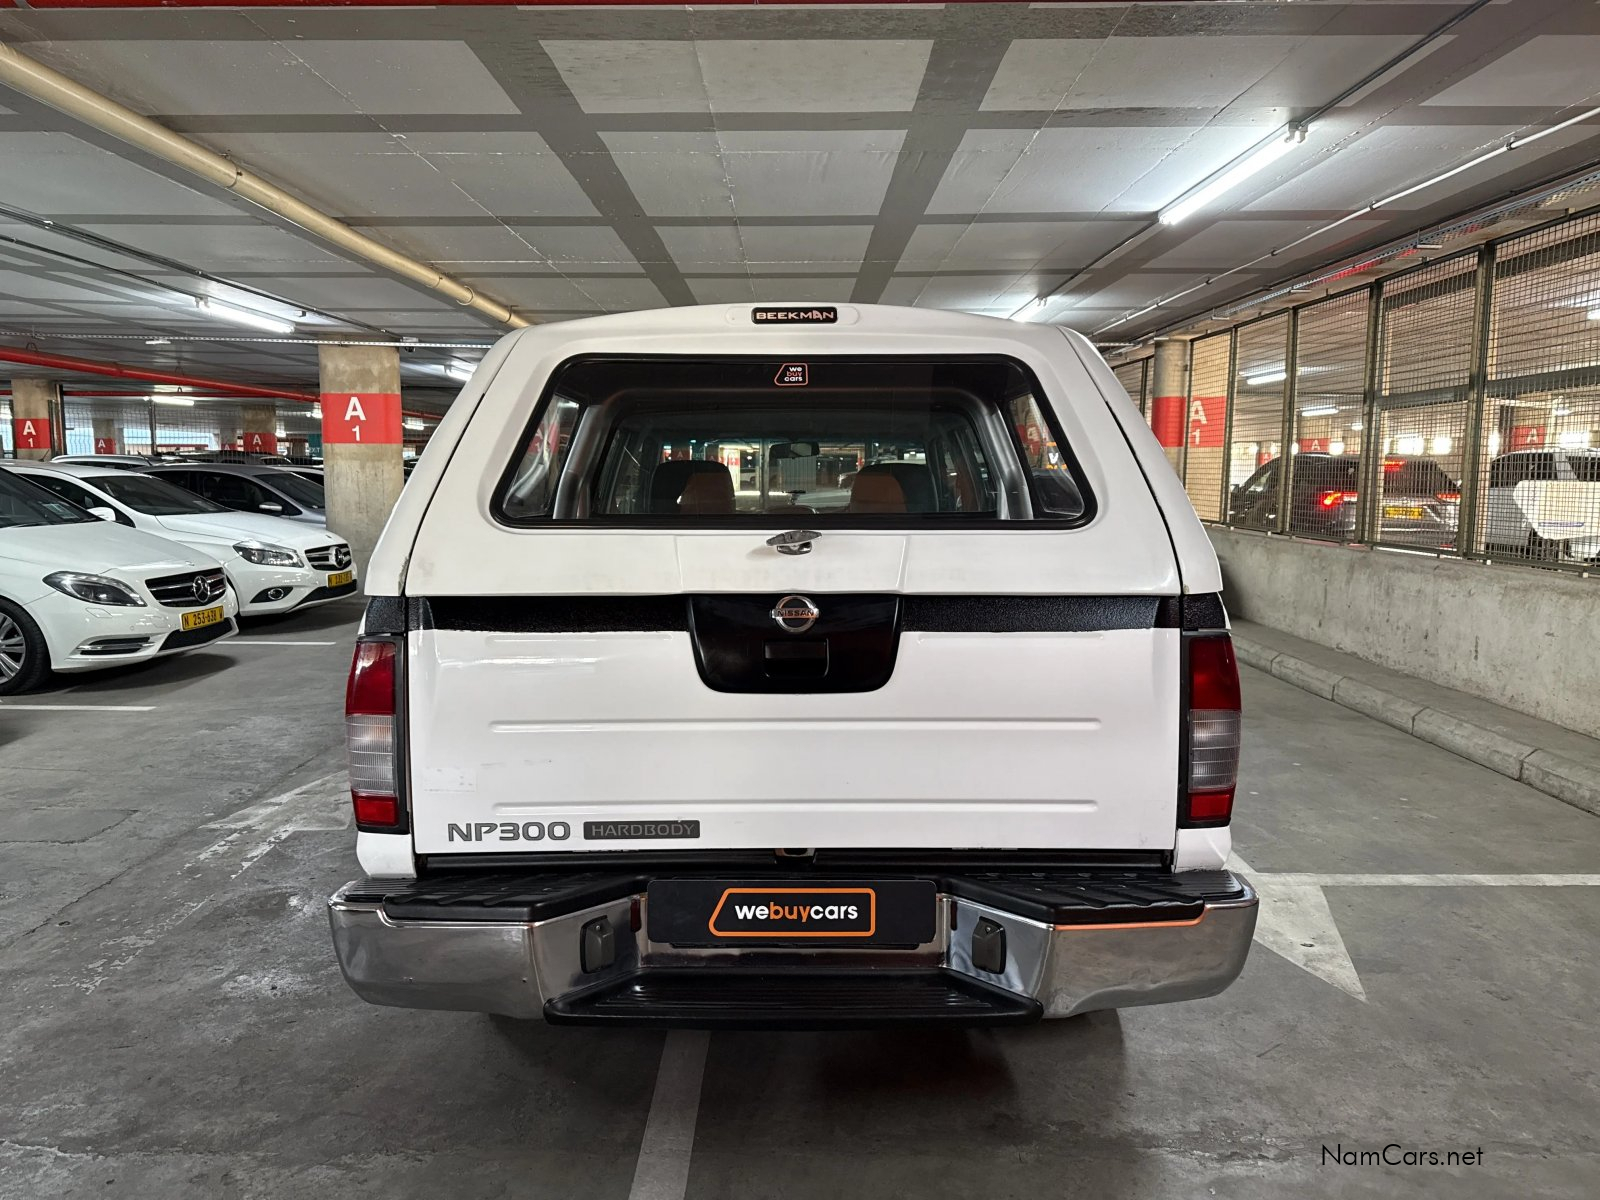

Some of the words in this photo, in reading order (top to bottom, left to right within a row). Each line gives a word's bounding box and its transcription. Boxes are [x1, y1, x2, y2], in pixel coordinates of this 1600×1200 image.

[756, 309, 834, 321] BEEKMAN
[344, 396, 367, 421] A
[1189, 400, 1207, 425] A
[23, 420, 36, 435] A
[351, 425, 360, 441] 1
[28, 437, 34, 448] 1
[98, 439, 106, 448] A
[253, 434, 262, 445] A
[1191, 428, 1200, 445] 1
[1311, 440, 1321, 451] A
[777, 609, 815, 617] NISSAN
[184, 614, 189, 628] N
[447, 821, 571, 842] NP300
[591, 822, 695, 838] HARDBODY
[735, 901, 859, 923] webuycars
